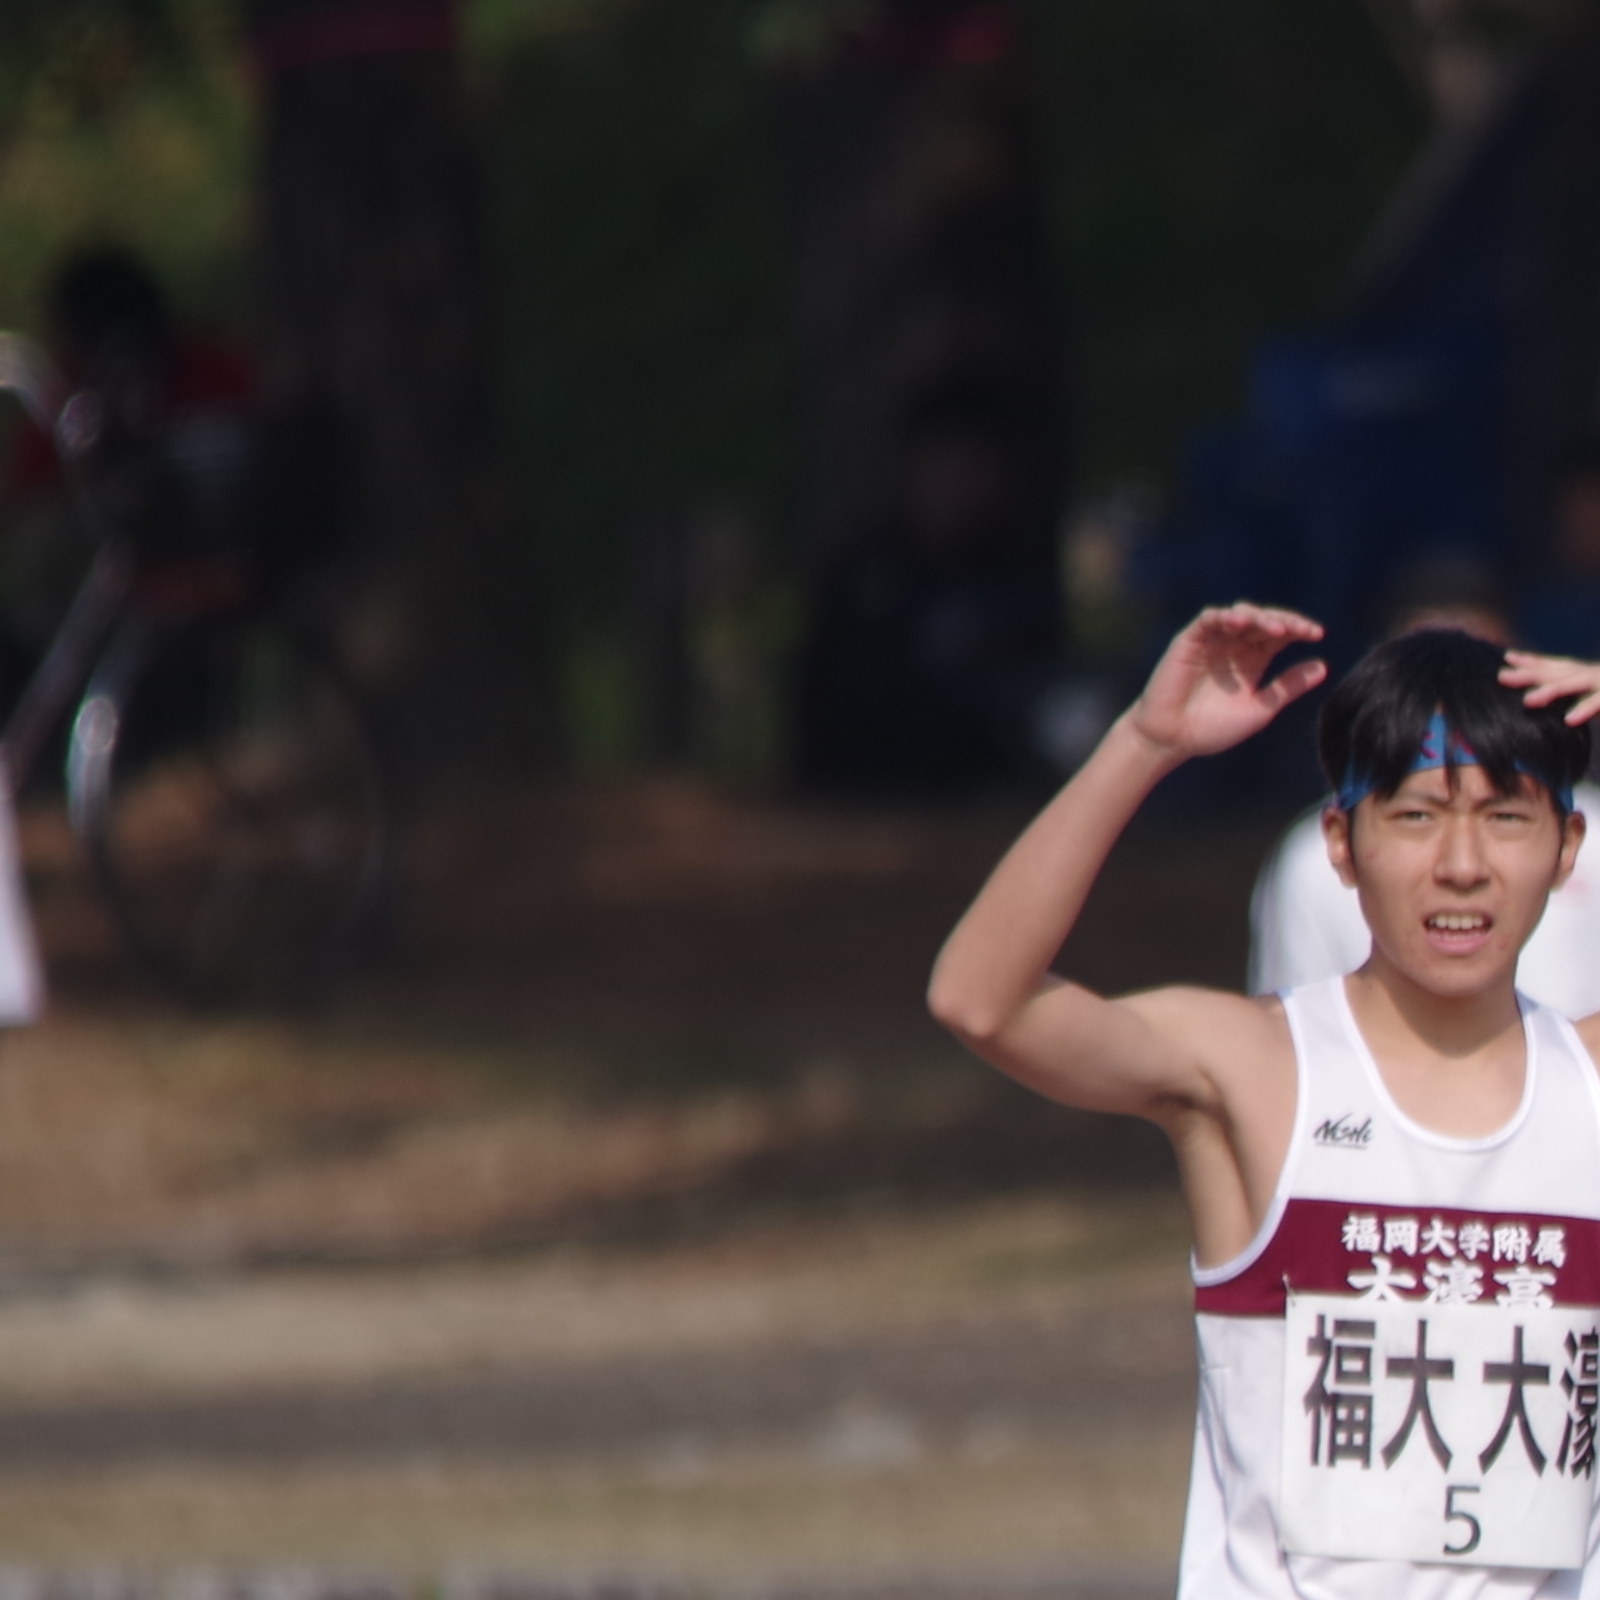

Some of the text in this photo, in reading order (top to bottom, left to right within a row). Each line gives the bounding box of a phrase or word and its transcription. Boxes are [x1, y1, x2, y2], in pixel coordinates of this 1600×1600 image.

[1342, 1214, 1567, 1268] 福岡大学附属
[1442, 1485, 1481, 1556] 5
